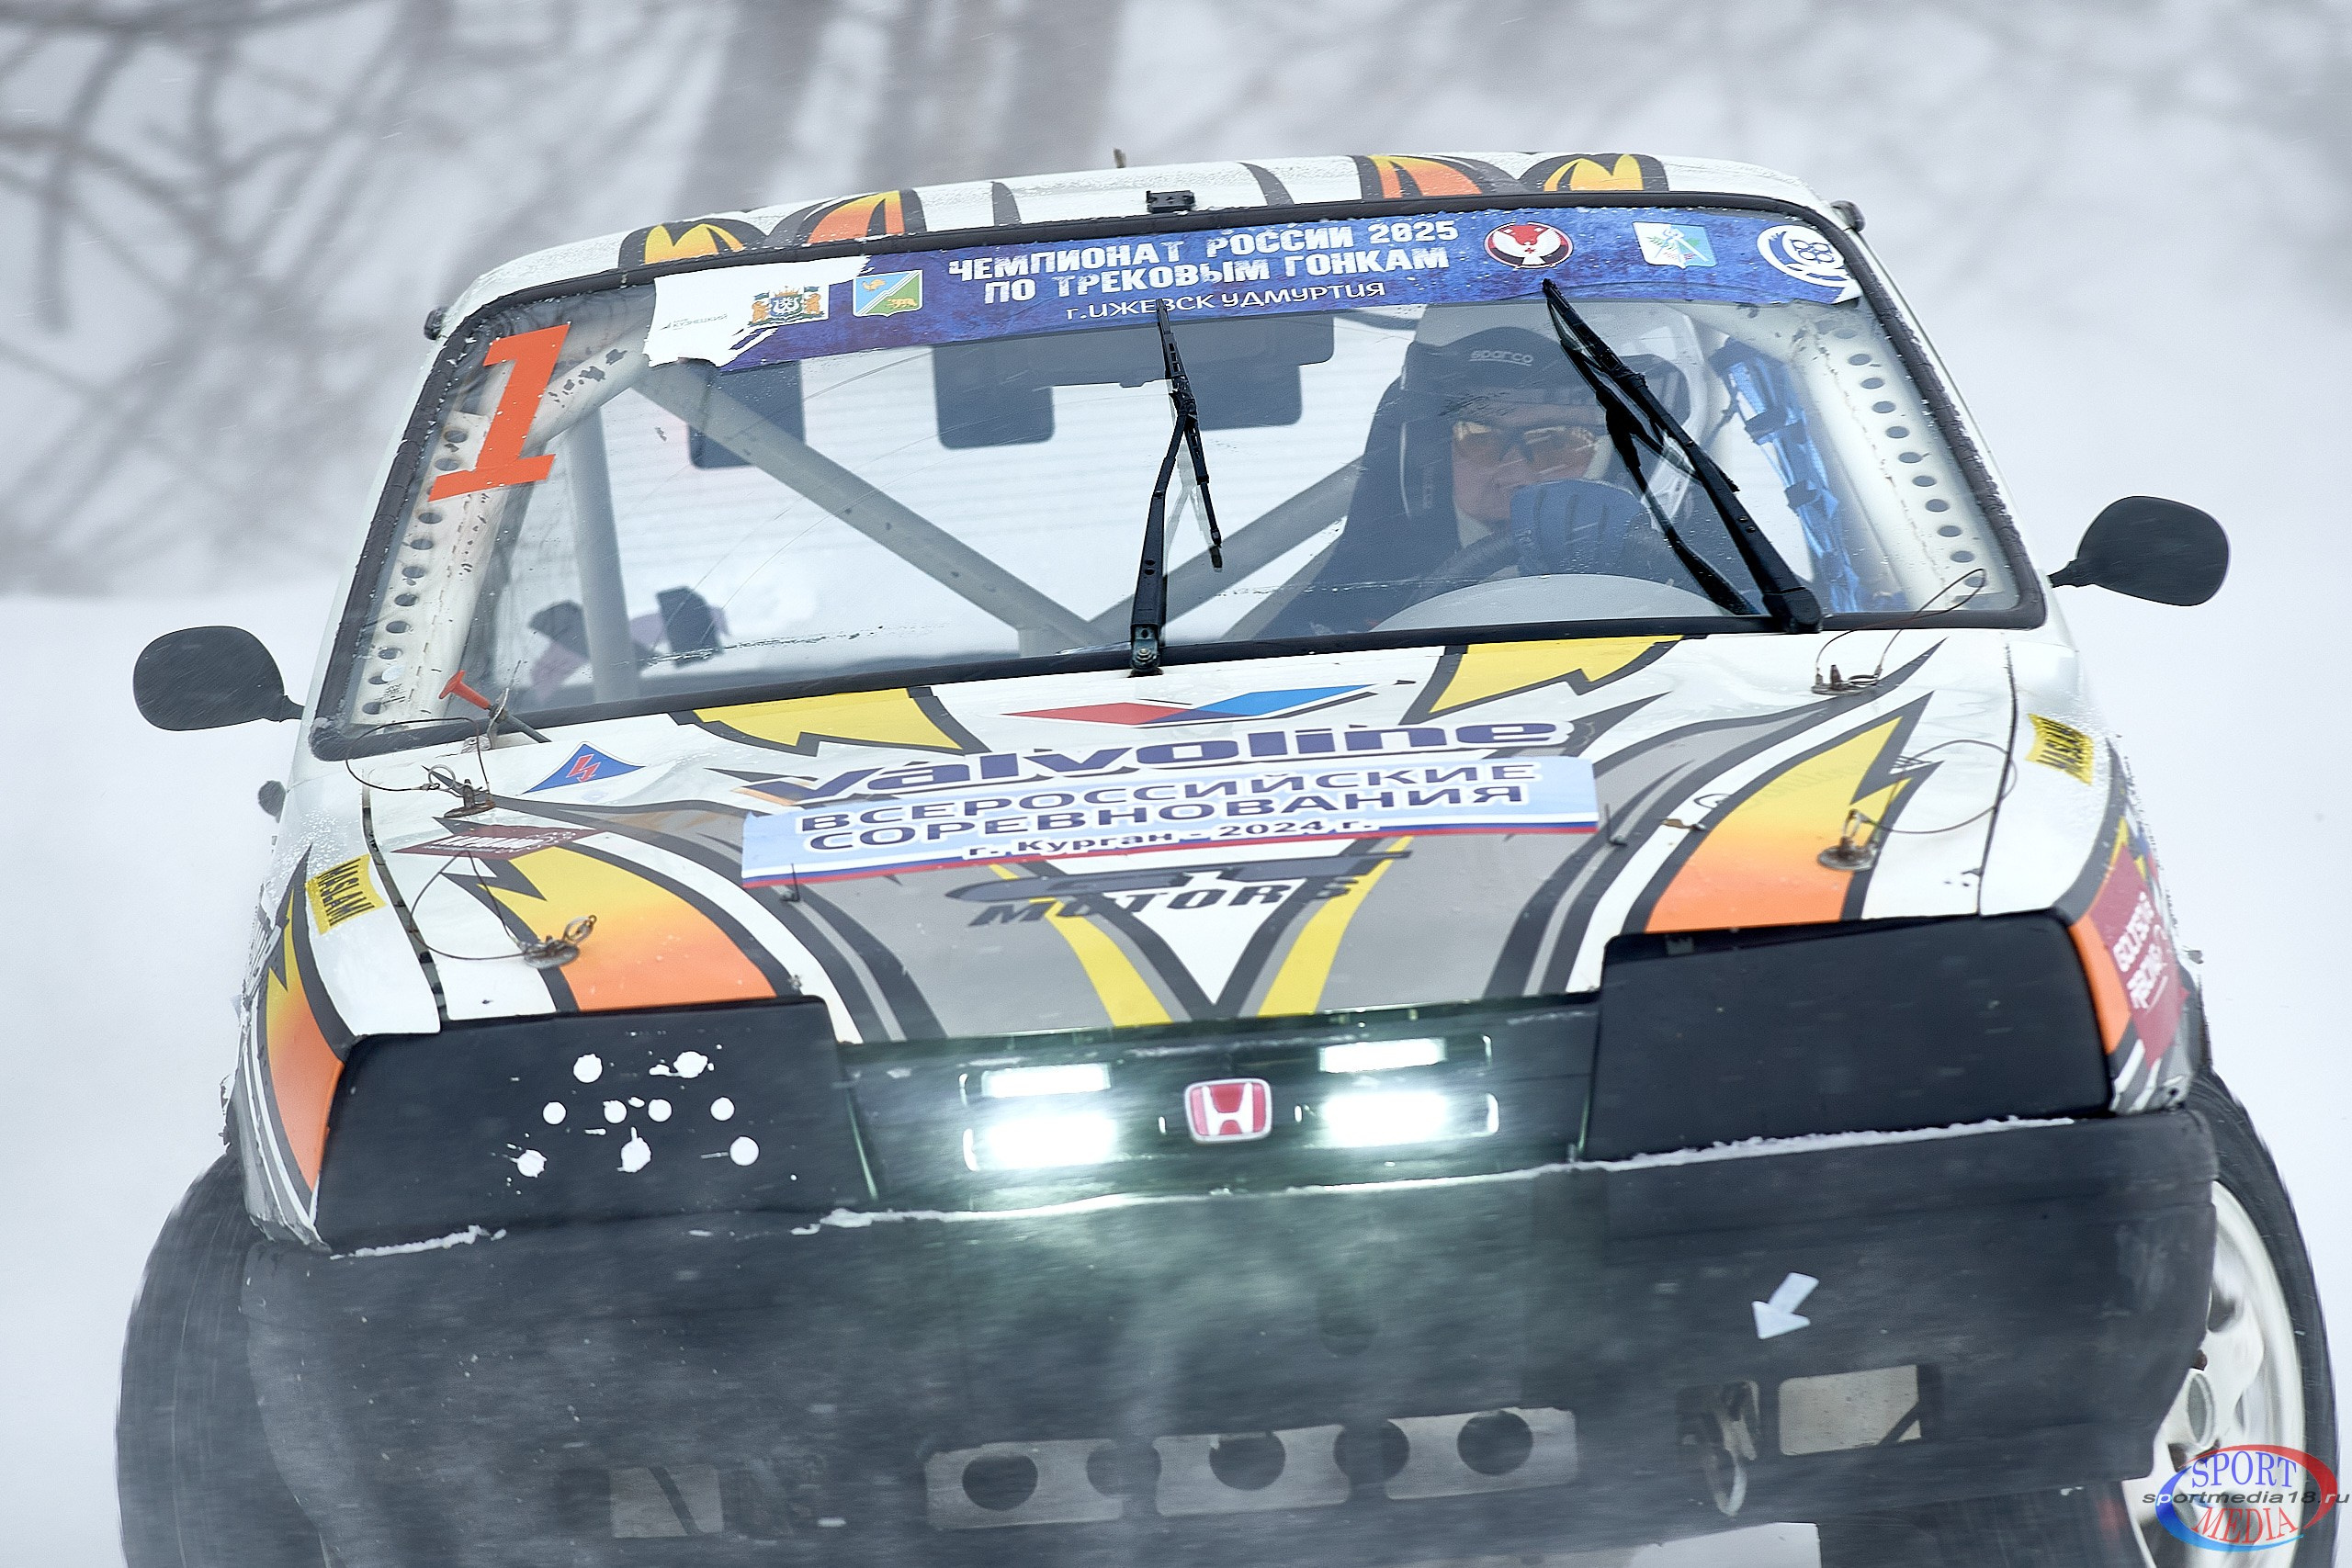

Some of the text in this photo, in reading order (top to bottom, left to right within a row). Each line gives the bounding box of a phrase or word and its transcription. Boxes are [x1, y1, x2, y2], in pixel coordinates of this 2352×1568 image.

[948, 220, 1459, 282] ЧЕМПИОНАТ РОССИИ 2025
[984, 246, 1450, 304] ПО ТРЕКОВЫМ ГОНКАМ
[1222, 282, 1385, 308] УДМУРТИЯ
[1471, 350, 1534, 365] sparco
[427, 323, 571, 502] 1
[740, 723, 1557, 800] valvoline
[801, 763, 1536, 832] ВСЕРОССИЙСКИЕ
[809, 785, 1523, 851] СОРЕВНОВАНИЯ
[1017, 832, 1173, 856] Курган
[1218, 819, 1324, 838] 2024
[316, 858, 375, 926] MASLAMI
